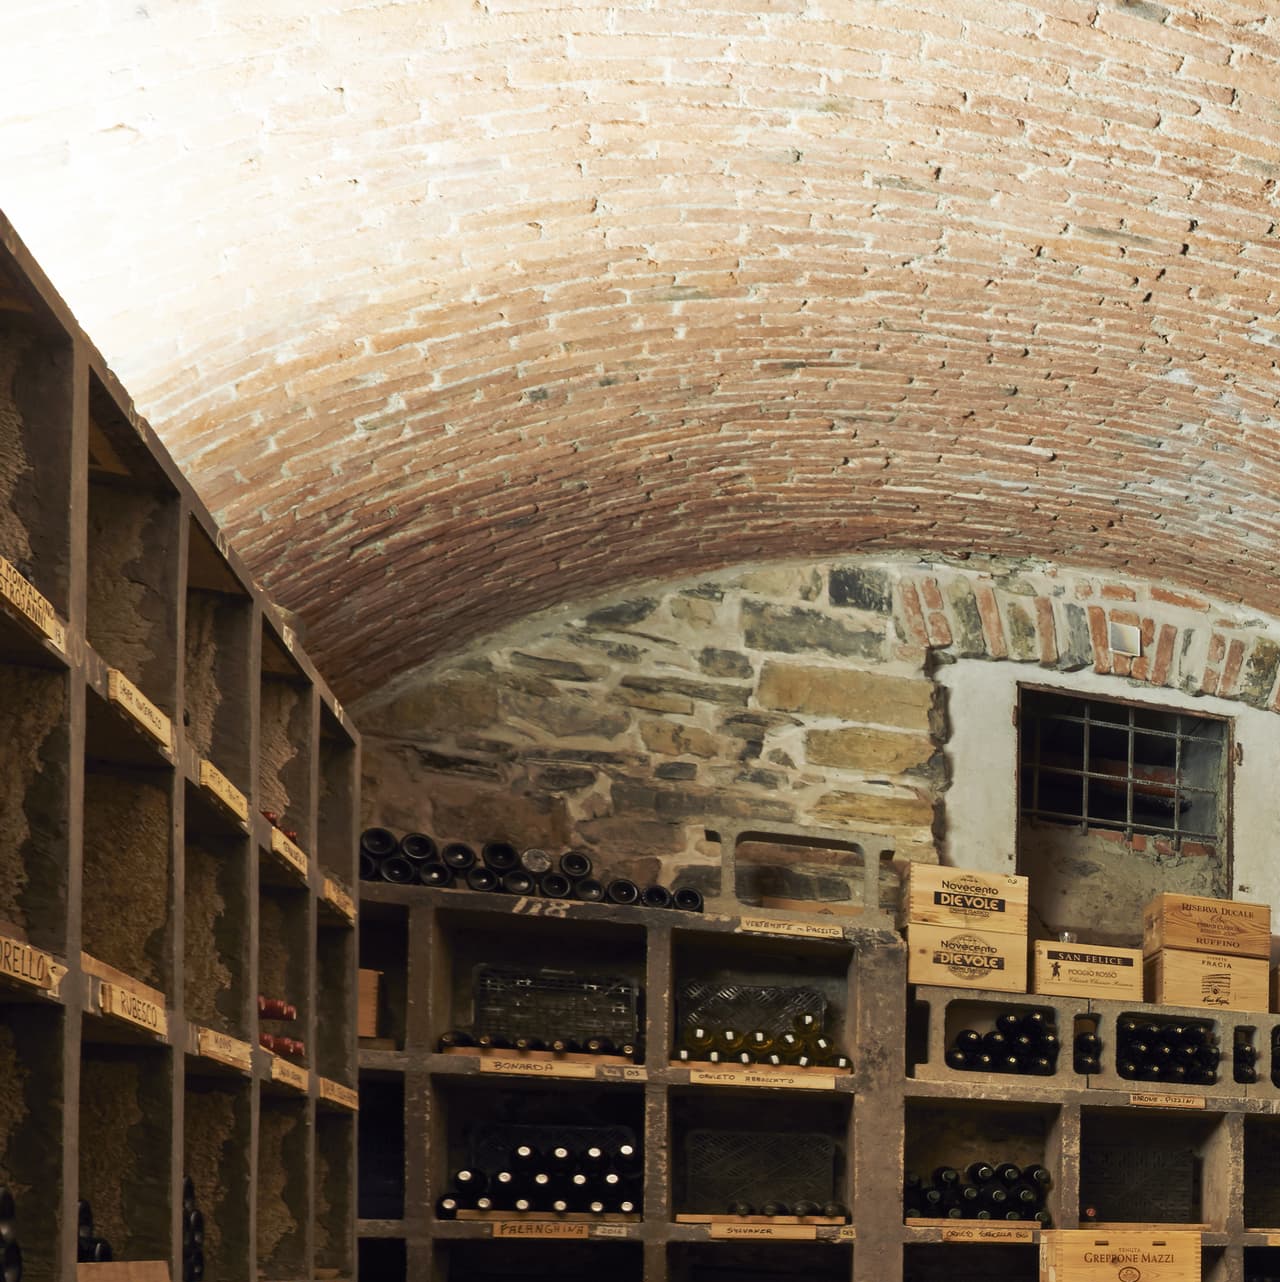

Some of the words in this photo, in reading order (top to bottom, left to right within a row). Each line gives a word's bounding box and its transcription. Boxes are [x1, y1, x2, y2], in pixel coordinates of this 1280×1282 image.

[941, 880, 999, 896] Novecento
[940, 893, 999, 911] DIEVOLE
[1181, 903, 1218, 915] RISERVA
[1221, 907, 1254, 919] DUCALE
[941, 940, 998, 955] Novecento
[1195, 938, 1240, 949] RUFFINO
[941, 953, 999, 970] DIEVOLE
[1058, 952, 1080, 961] SAN
[1085, 955, 1122, 965] FELICE
[493, 1060, 554, 1074] BONARDA
[1083, 1252, 1138, 1264] GREPPONE
[1141, 1252, 1175, 1264] MAZZI
